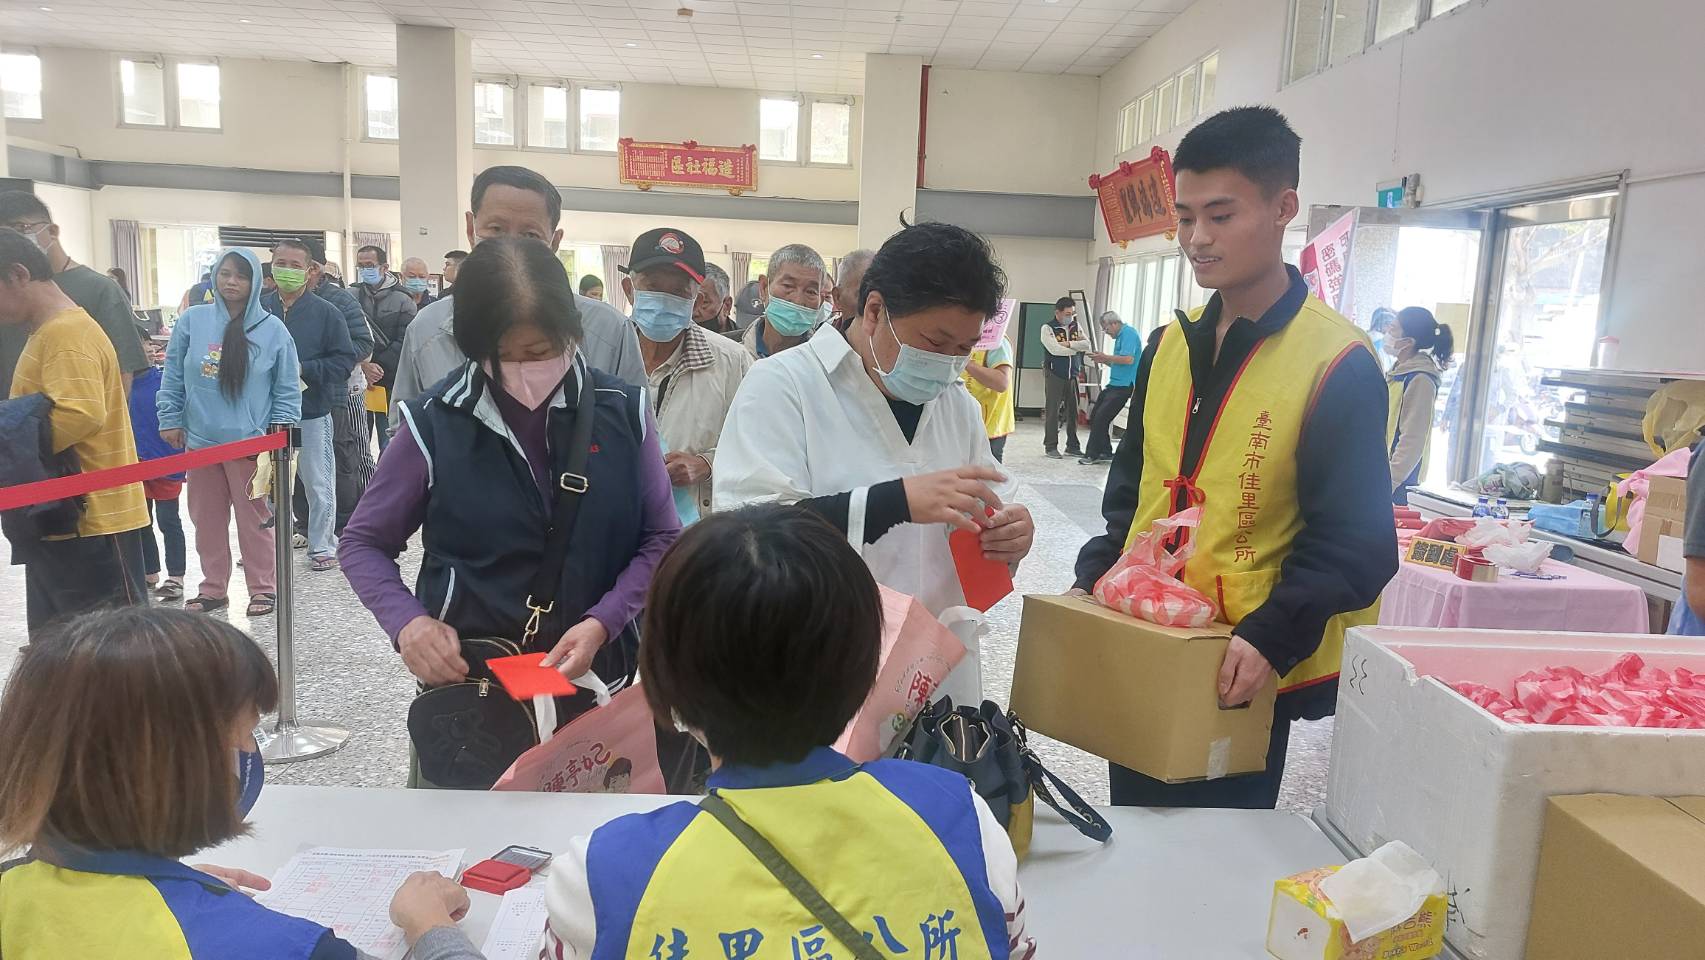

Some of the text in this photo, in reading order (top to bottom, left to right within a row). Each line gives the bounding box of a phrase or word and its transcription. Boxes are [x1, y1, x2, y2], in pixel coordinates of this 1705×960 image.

[1233, 410, 1273, 564] 臺南市佳里區公所
